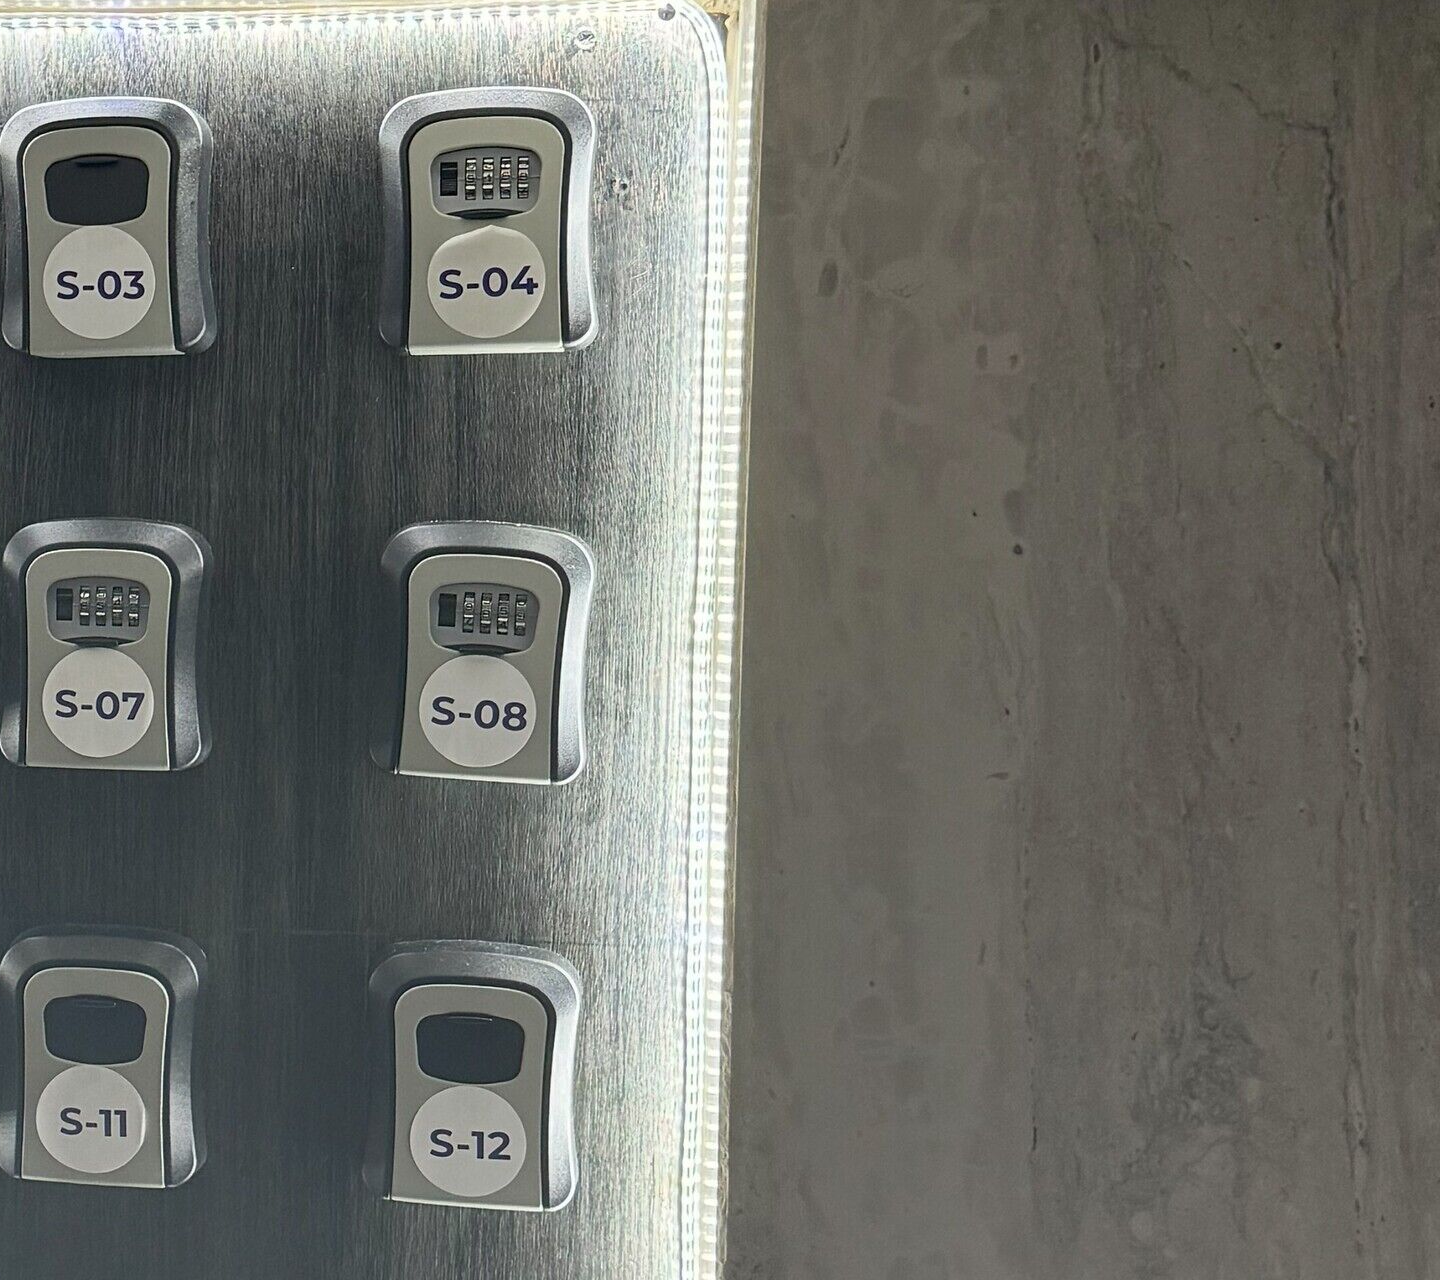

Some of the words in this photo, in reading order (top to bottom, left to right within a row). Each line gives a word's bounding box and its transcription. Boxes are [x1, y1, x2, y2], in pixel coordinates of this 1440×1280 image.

[56, 270, 145, 300] S-03
[439, 265, 539, 300] S-04
[55, 689, 145, 721] S-07
[430, 696, 527, 732] S-08
[60, 1107, 128, 1138] S-11
[429, 1128, 511, 1161] S-12
